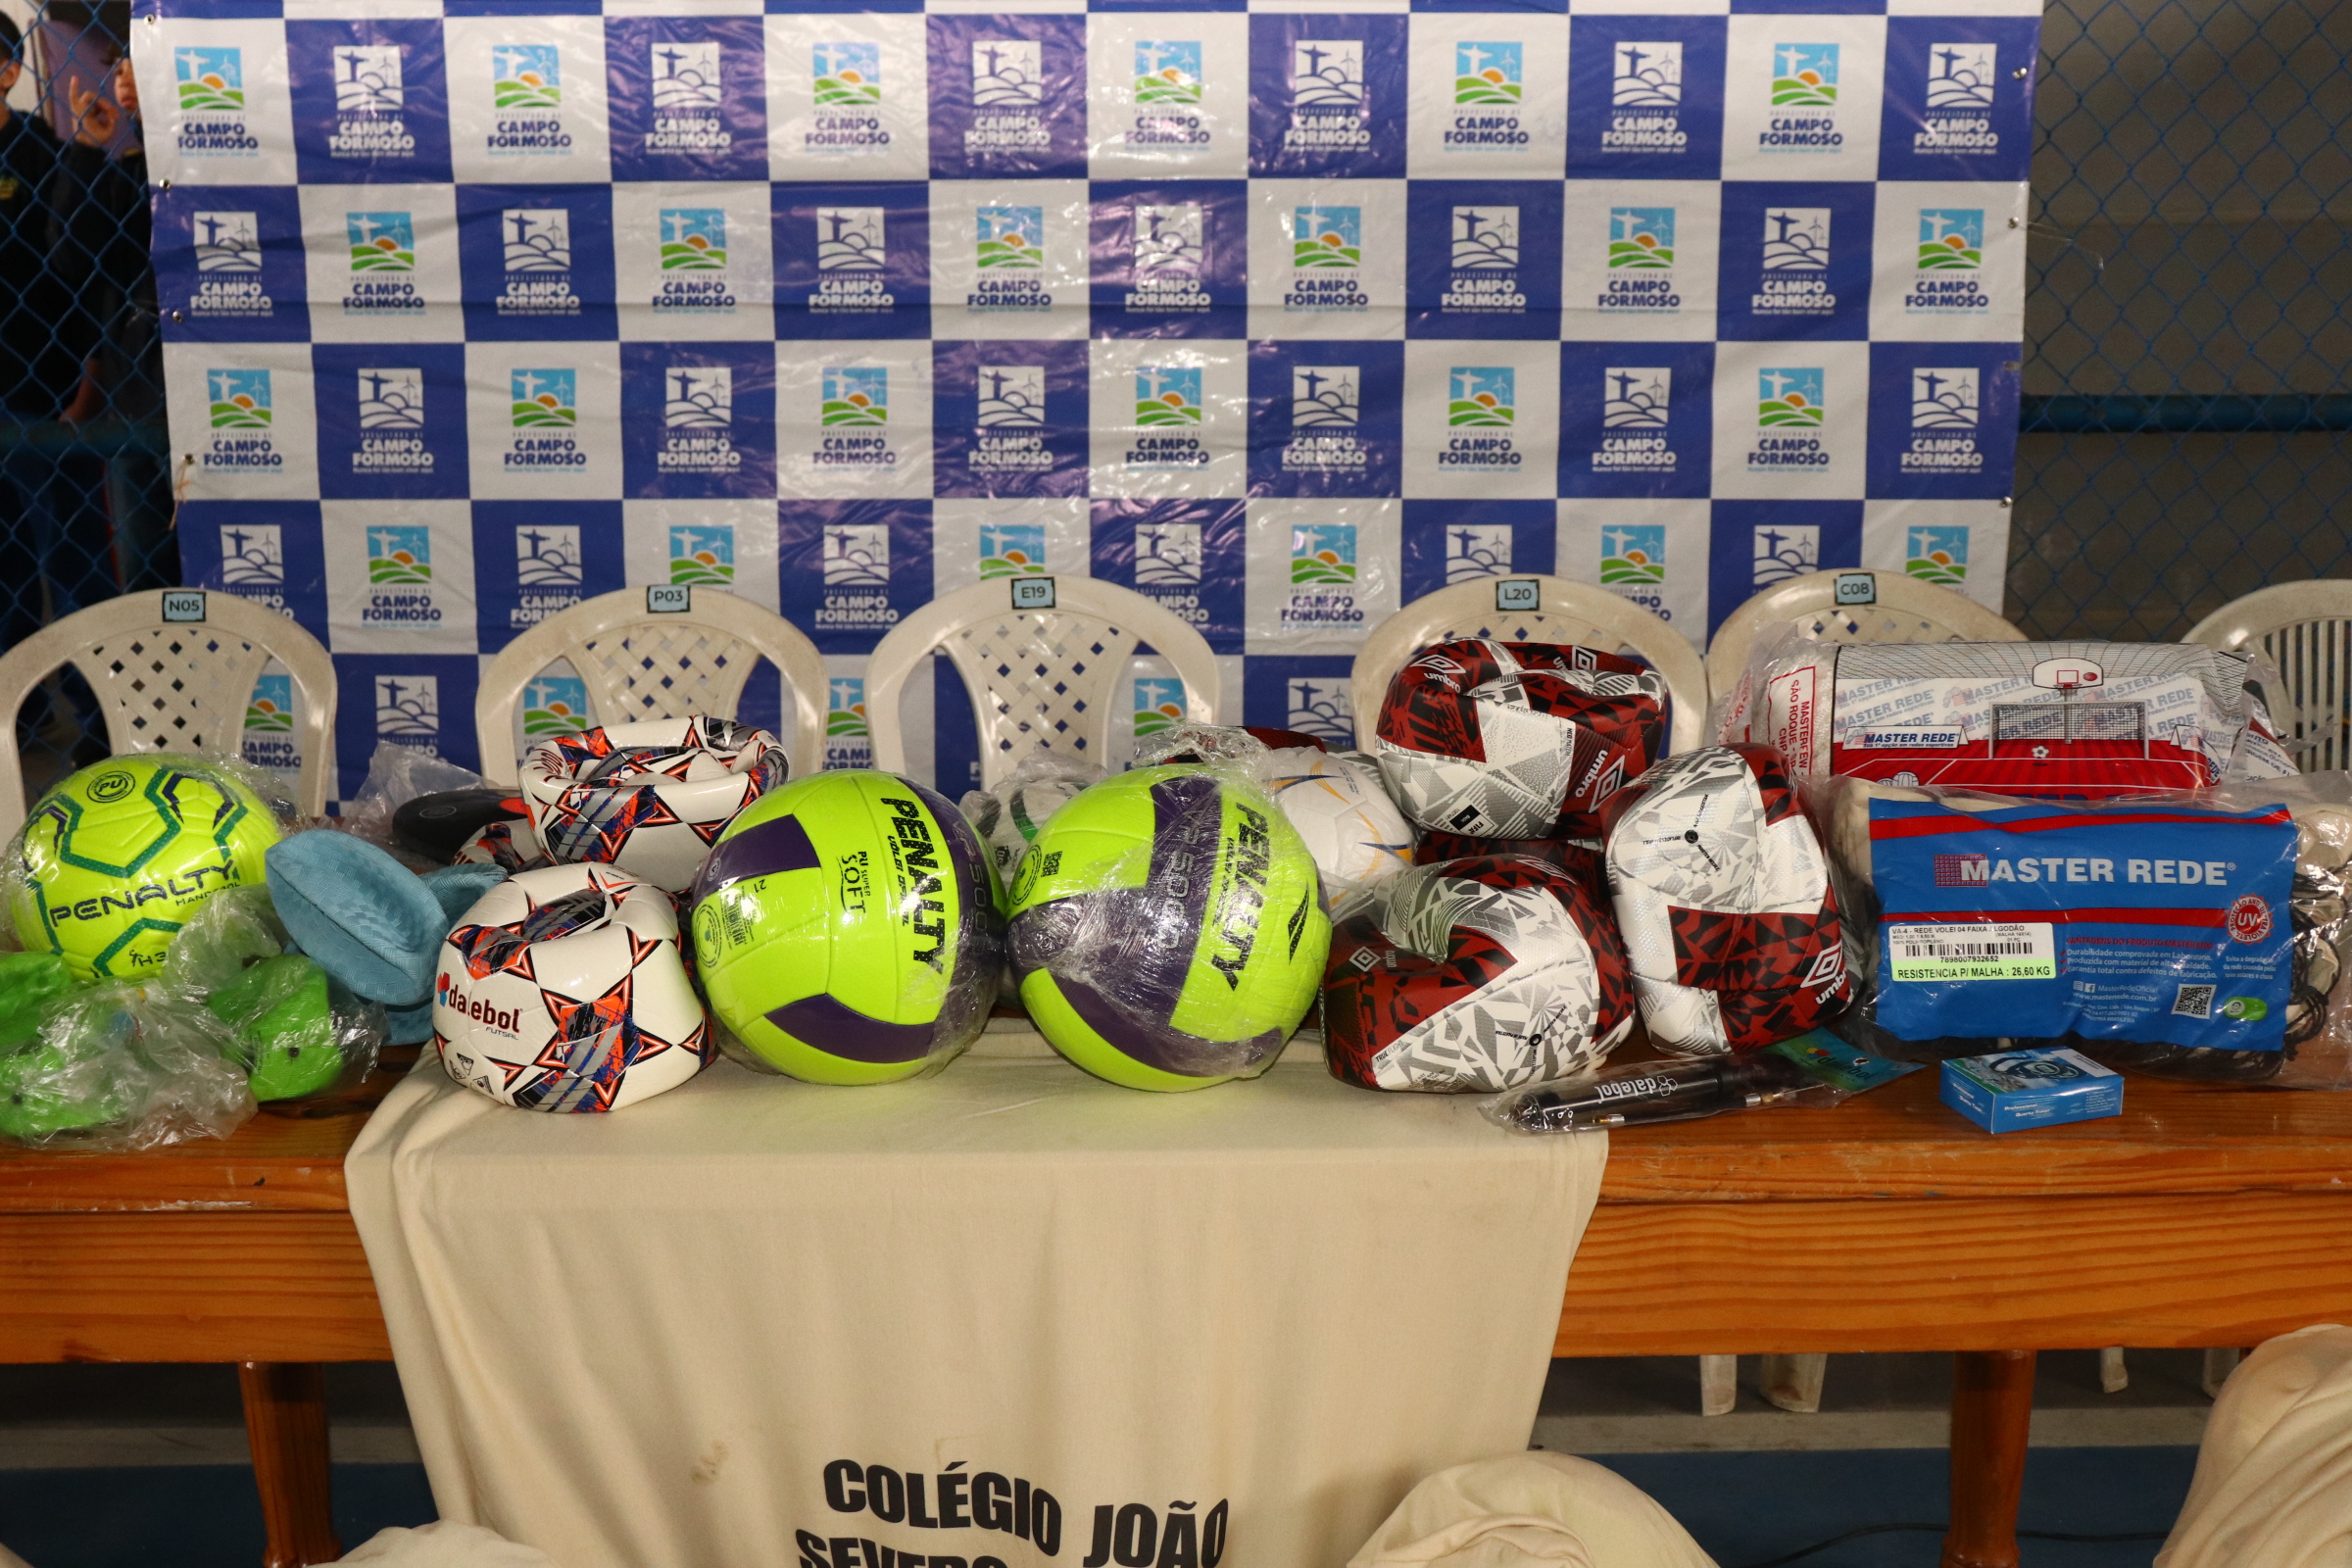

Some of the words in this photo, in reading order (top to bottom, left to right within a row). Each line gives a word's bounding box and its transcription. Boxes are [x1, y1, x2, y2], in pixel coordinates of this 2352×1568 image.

[185, 123, 246, 136] CAMPO
[340, 122, 404, 135] CAMPO
[498, 121, 561, 133] CAMPO
[656, 119, 719, 132] CAMPO
[815, 118, 879, 131] CAMPO
[975, 117, 1039, 130] CAMPO
[1455, 118, 1518, 130] CAMPO
[1613, 118, 1676, 131] CAMPO
[1771, 120, 1833, 132] CAMPO
[1926, 119, 1987, 132] CAMPO
[175, 137, 257, 151] FORMOSO
[329, 135, 415, 150] FORMOSO
[487, 135, 571, 149] FORMOSO
[645, 132, 730, 147] FORMOSO
[805, 132, 890, 146] FORMOSO
[964, 130, 1050, 145] FORMOSO
[1445, 131, 1529, 145] FORMOSO
[1602, 131, 1687, 146] FORMOSO
[1760, 133, 1843, 147] FORMOSO
[1915, 133, 1998, 148] FORMOSO
[200, 282, 261, 295] CAMPO
[353, 284, 414, 296] CAMPO
[508, 282, 568, 294] CAMPO
[663, 283, 724, 295] CAMPO
[820, 280, 882, 293] CAMPO
[978, 281, 1041, 294] CAMPO
[1296, 280, 1357, 293] CAMPO
[1452, 279, 1515, 292] CAMPO
[1609, 281, 1670, 294] CAMPO
[1763, 280, 1825, 294] CAMPO
[1917, 282, 1978, 294] CAMPO
[190, 296, 271, 310] FORMOSO
[343, 297, 424, 310] FORMOSO
[497, 295, 579, 309] FORMOSO
[653, 296, 735, 309] FORMOSO
[809, 293, 893, 307] FORMOSO
[967, 294, 1052, 308] FORMOSO
[1285, 294, 1368, 307] FORMOSO
[1442, 293, 1526, 307] FORMOSO
[1599, 294, 1680, 308] FORMOSO
[1752, 294, 1836, 309] FORMOSO
[1906, 295, 1988, 308] FORMOSO
[214, 441, 271, 453] CAMPO
[363, 439, 422, 452] CAMPO
[514, 440, 576, 452] CAMPO
[668, 438, 729, 451] CAMPO
[824, 438, 885, 451] CAMPO
[980, 437, 1042, 451] CAMPO
[1137, 438, 1199, 450] CAMPO
[1293, 437, 1355, 451] CAMPO
[1449, 439, 1511, 452] CAMPO
[1603, 438, 1665, 451] CAMPO
[1758, 439, 1819, 452] CAMPO
[1912, 439, 1974, 452] CAMPO
[204, 454, 281, 466] FORMOSO
[353, 453, 432, 466] FORMOSO
[505, 453, 586, 466] FORMOSO
[658, 452, 740, 466] FORMOSO
[813, 451, 896, 465] FORMOSO
[969, 451, 1053, 466] FORMOSO
[1126, 451, 1209, 464] FORMOSO
[1282, 451, 1366, 465] FORMOSO
[1440, 453, 1521, 466] FORMOSO
[1592, 452, 1676, 466] FORMOSO
[1748, 453, 1830, 466] FORMOSO
[1902, 453, 1984, 466] FORMOSO
[1021, 586, 1046, 599] E19
[1504, 588, 1532, 600] L20
[1841, 583, 1870, 595] C08
[372, 596, 431, 608] CAMPO
[655, 590, 683, 602] P03
[1292, 596, 1352, 609] CAMPO
[170, 600, 200, 612] N05
[826, 597, 886, 609] CAMPO
[362, 609, 441, 622] FORMOSO
[815, 610, 898, 623] FORMOSO
[1282, 610, 1363, 623] FORMOSO
[1424, 671, 1462, 693] umbro
[1789, 680, 1801, 703] SÃO
[2158, 688, 2193, 707] REDE
[1788, 705, 1798, 745] ROQUE
[2158, 715, 2194, 733] REDE
[1799, 702, 1809, 768] MASTERFEW
[1864, 733, 1918, 743] MASTER
[1921, 733, 1956, 743] REDE
[1575, 749, 1608, 799] umbro
[99, 779, 122, 793] PU
[858, 851, 869, 866] PU
[1960, 858, 2115, 883] MASTER
[841, 854, 866, 913] SOFT
[860, 869, 871, 897] SUPER
[880, 797, 945, 975] PENALTY
[49, 858, 235, 928] PENALTY
[1211, 802, 1270, 992] PENALTY
[1157, 852, 1195, 950] 5000
[2237, 912, 2258, 927] UV
[1898, 968, 1958, 979] RESISTENCIA
[1960, 968, 1969, 978] P/
[1971, 967, 2004, 977] MALHA
[2012, 966, 2034, 977] 26,60
[2036, 966, 2050, 976] KG
[2067, 965, 2096, 974] Garantia
[2097, 966, 2115, 975] total
[2138, 967, 2167, 976] defeitos
[485, 1026, 519, 1041] FUTSAL
[1375, 1050, 1391, 1063] TRUE
[1817, 1056, 1879, 1079] dalebol
[1594, 1078, 1656, 1102] dalebol
[823, 1459, 1061, 1557] COLÉGIO
[1082, 1498, 1228, 1568] JOÃO
